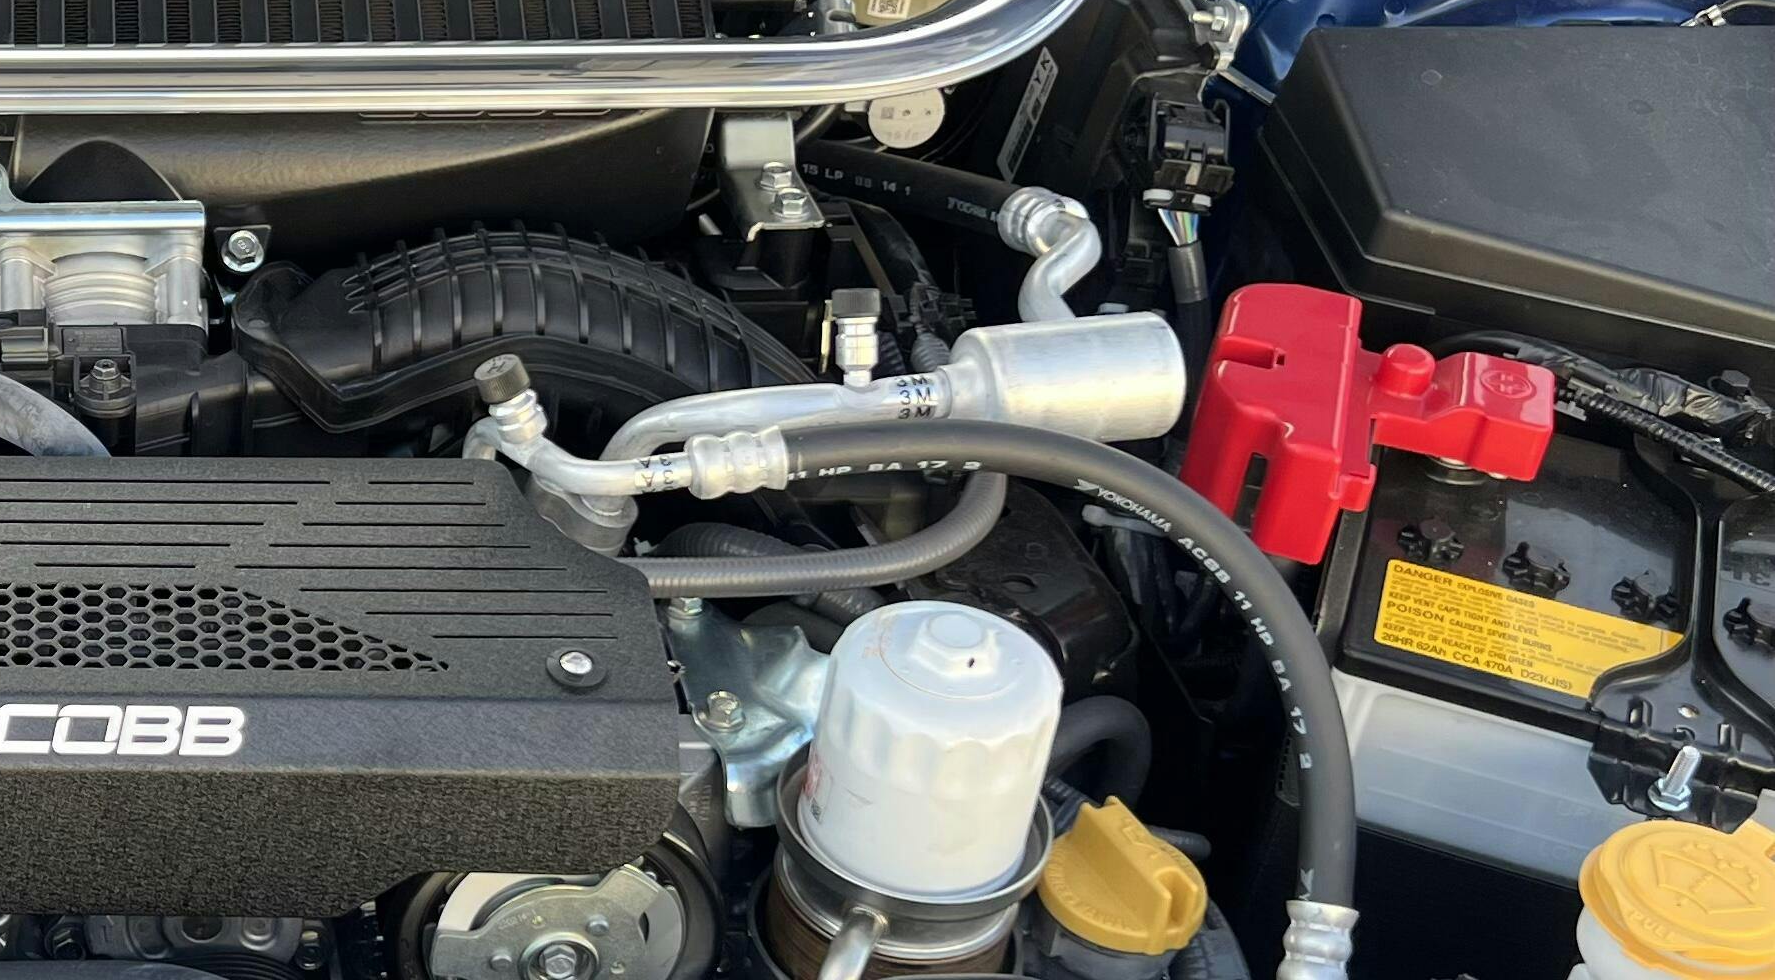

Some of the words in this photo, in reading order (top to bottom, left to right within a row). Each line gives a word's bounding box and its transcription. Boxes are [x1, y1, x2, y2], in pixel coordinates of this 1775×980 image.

[825, 166, 844, 180] LP
[881, 180, 897, 193] 14
[818, 466, 852, 477] HP
[916, 460, 948, 469] 17
[1393, 563, 1453, 587] DANGER
[1096, 487, 1172, 533] YOKOHAMA
[1233, 590, 1253, 611] 11
[1250, 617, 1274, 646] HP
[1290, 706, 1307, 735] 17
[1386, 599, 1444, 623] POISON
[1491, 617, 1510, 629] AND
[1452, 650, 1480, 665] CCA
